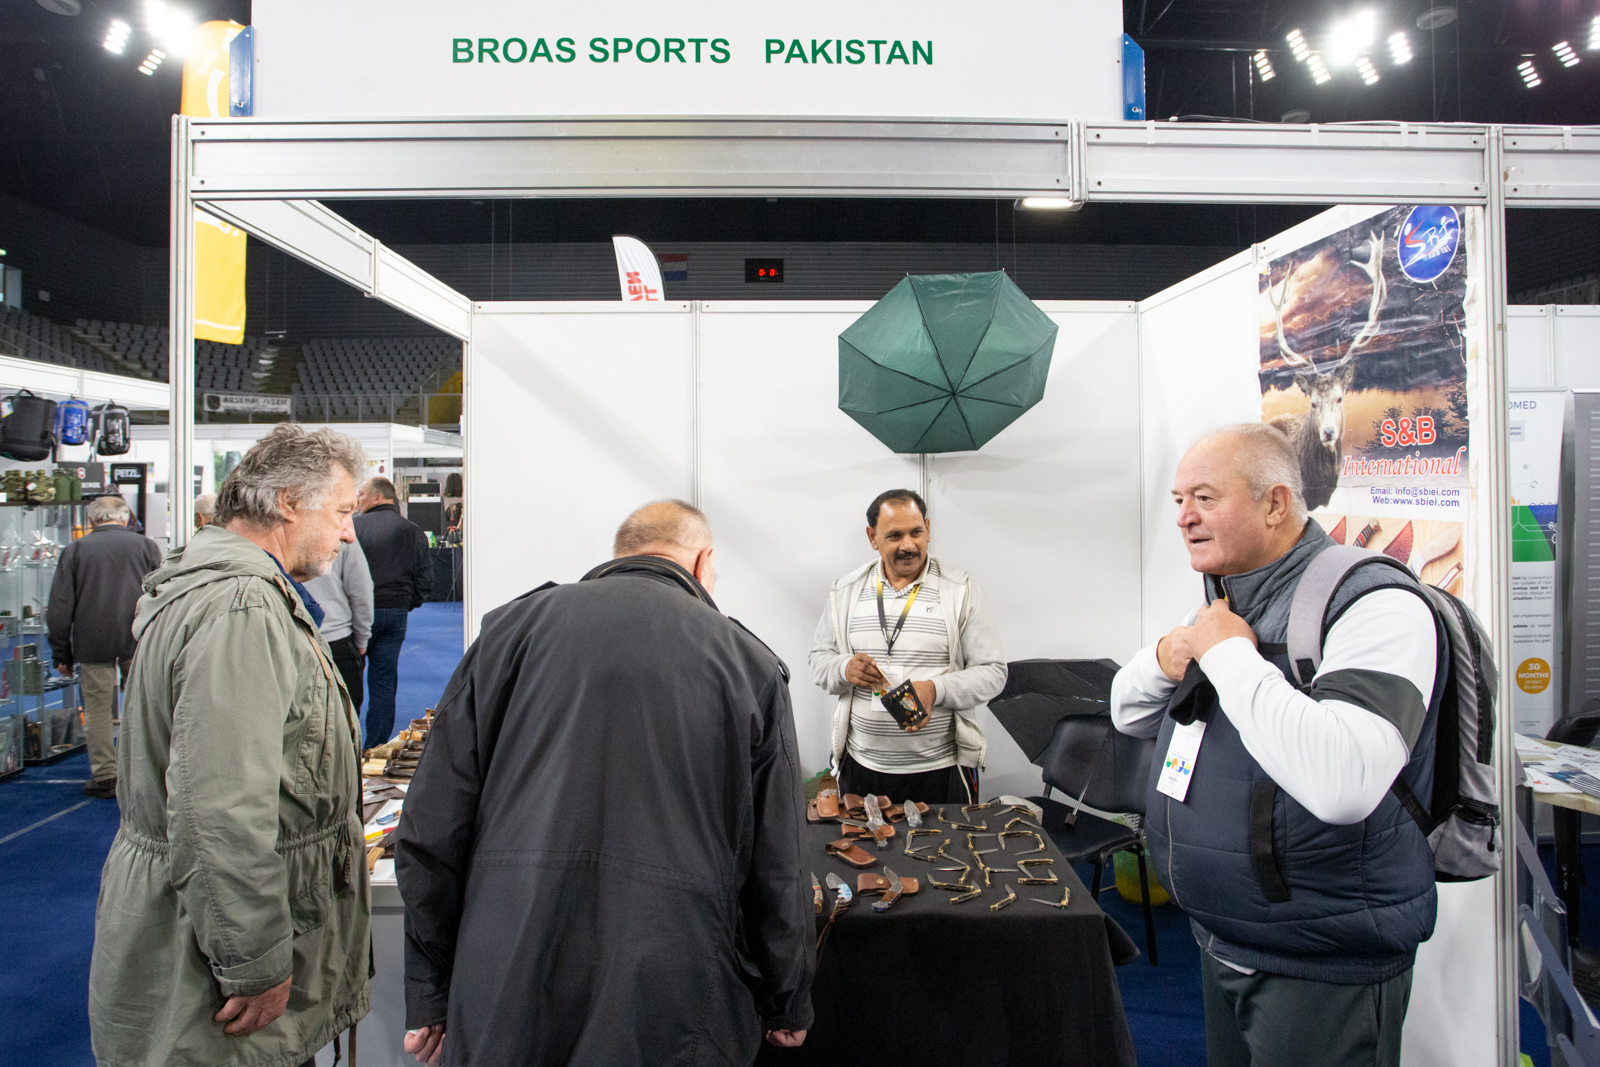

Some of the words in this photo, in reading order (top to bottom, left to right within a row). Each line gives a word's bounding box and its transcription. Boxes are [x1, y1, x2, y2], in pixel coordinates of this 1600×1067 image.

[452, 37, 576, 63] BROAS
[589, 37, 731, 64] SPORTS
[765, 38, 934, 66] PAKISTAN
[1380, 415, 1437, 447] S&B
[1342, 445, 1467, 478] International
[114, 468, 142, 481] PETZL
[1370, 486, 1393, 495] Email:
[1395, 487, 1460, 497] Info@sbiei.com
[1372, 496, 1460, 507] Web:www.sbiei.com
[1528, 663, 1541, 671] 30
